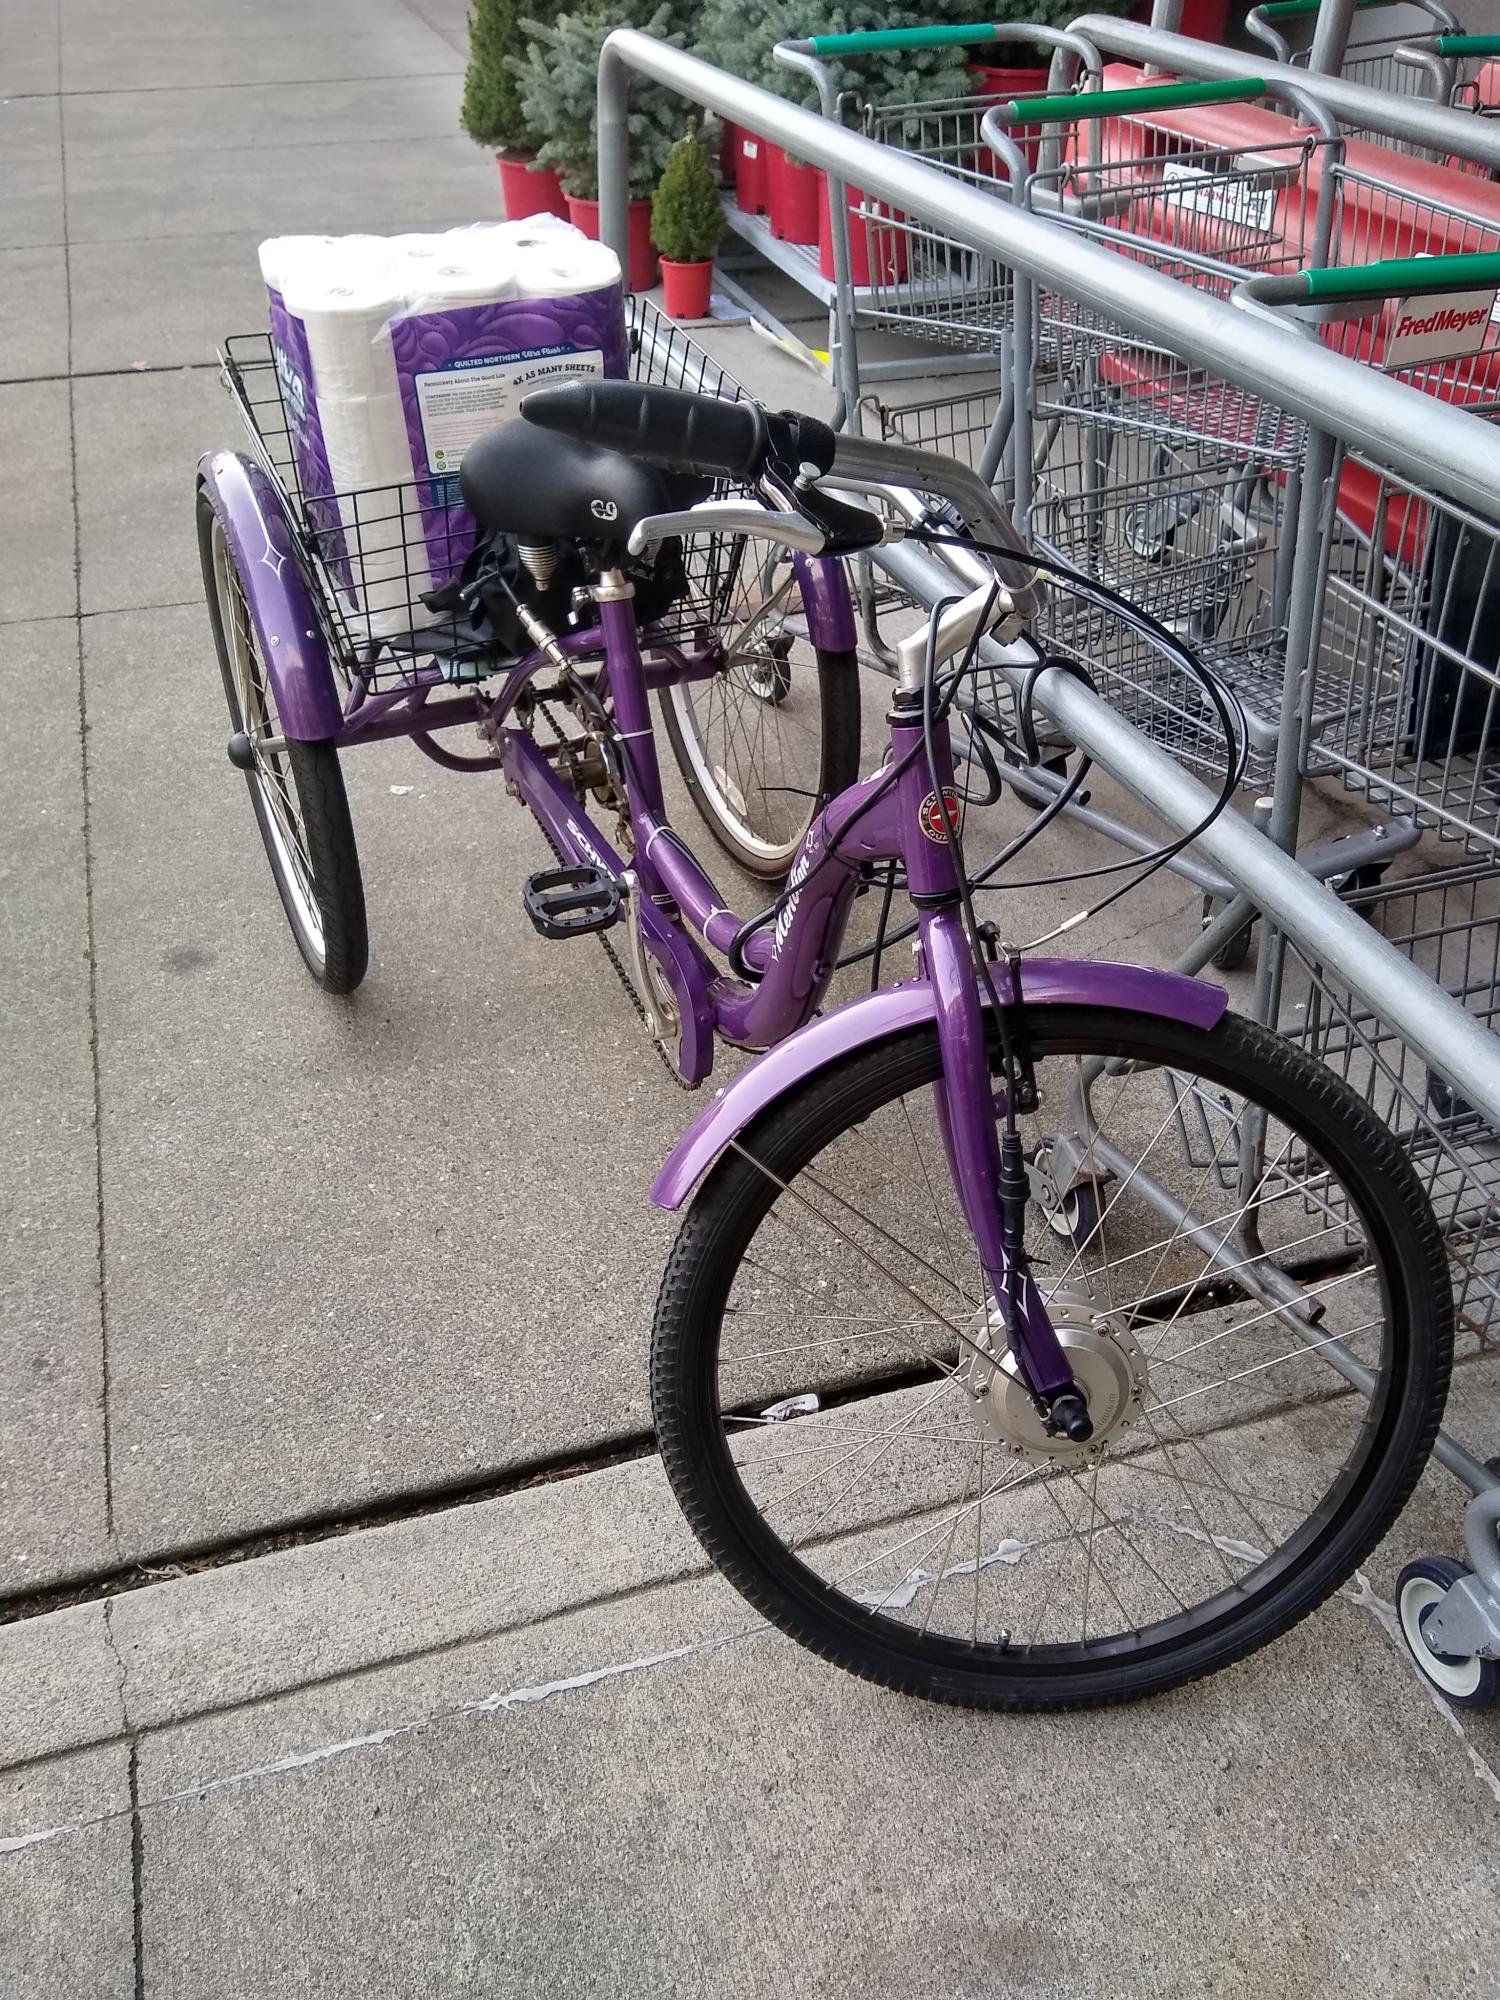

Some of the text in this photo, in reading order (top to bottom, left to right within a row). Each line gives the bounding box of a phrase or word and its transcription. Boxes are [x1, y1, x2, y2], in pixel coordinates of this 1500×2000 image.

[454, 358, 483, 368] QUILTED
[484, 353, 520, 364] NORTHERN
[513, 376, 524, 386] 4X
[526, 371, 536, 380] AS
[538, 364, 562, 376] MANY
[565, 363, 596, 373] SHEETS
